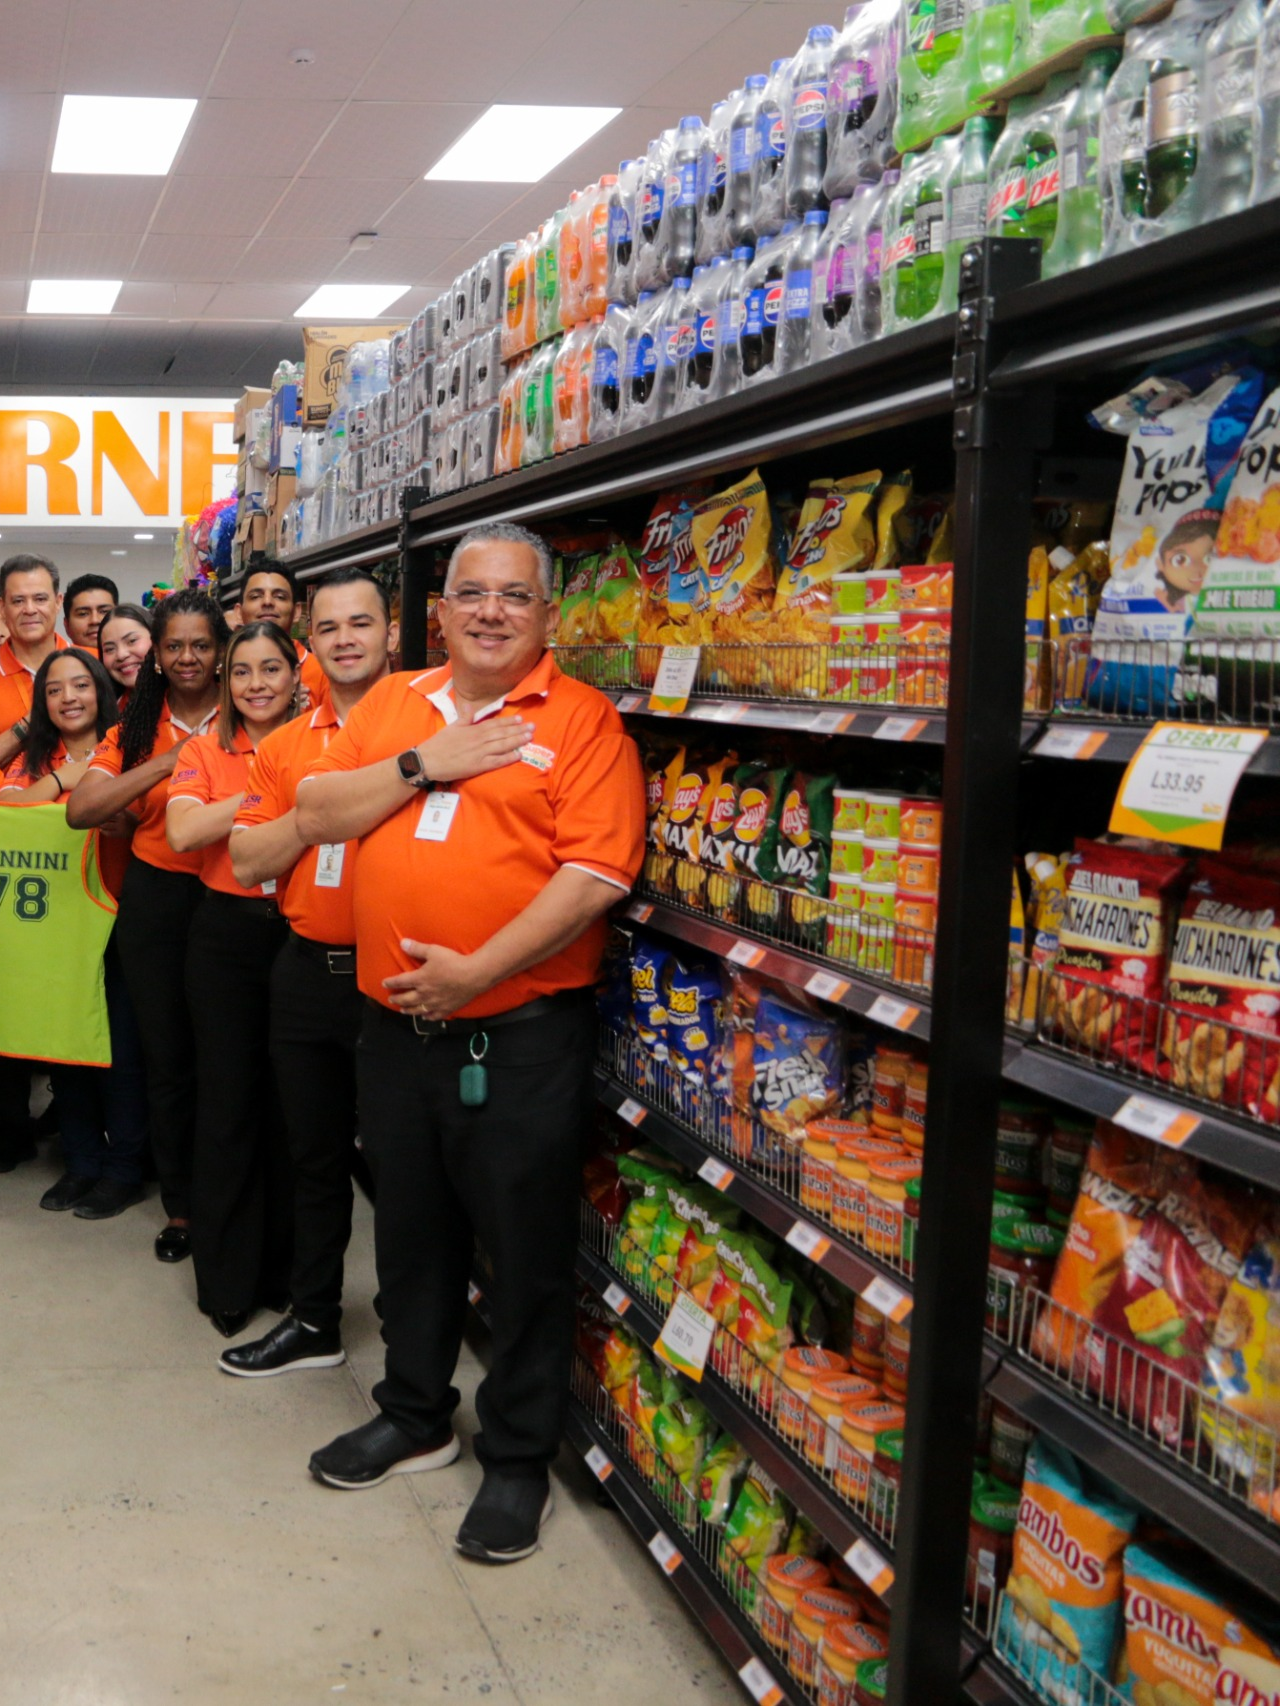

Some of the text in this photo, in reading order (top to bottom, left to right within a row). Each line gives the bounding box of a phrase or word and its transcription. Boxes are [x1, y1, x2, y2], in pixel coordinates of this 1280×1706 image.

[1165, 729, 1243, 750] OFERTA
[1150, 770, 1205, 794] L33.95
[1070, 869, 1140, 902] DEL RANCHO
[1019, 1499, 1101, 1585] ambos
